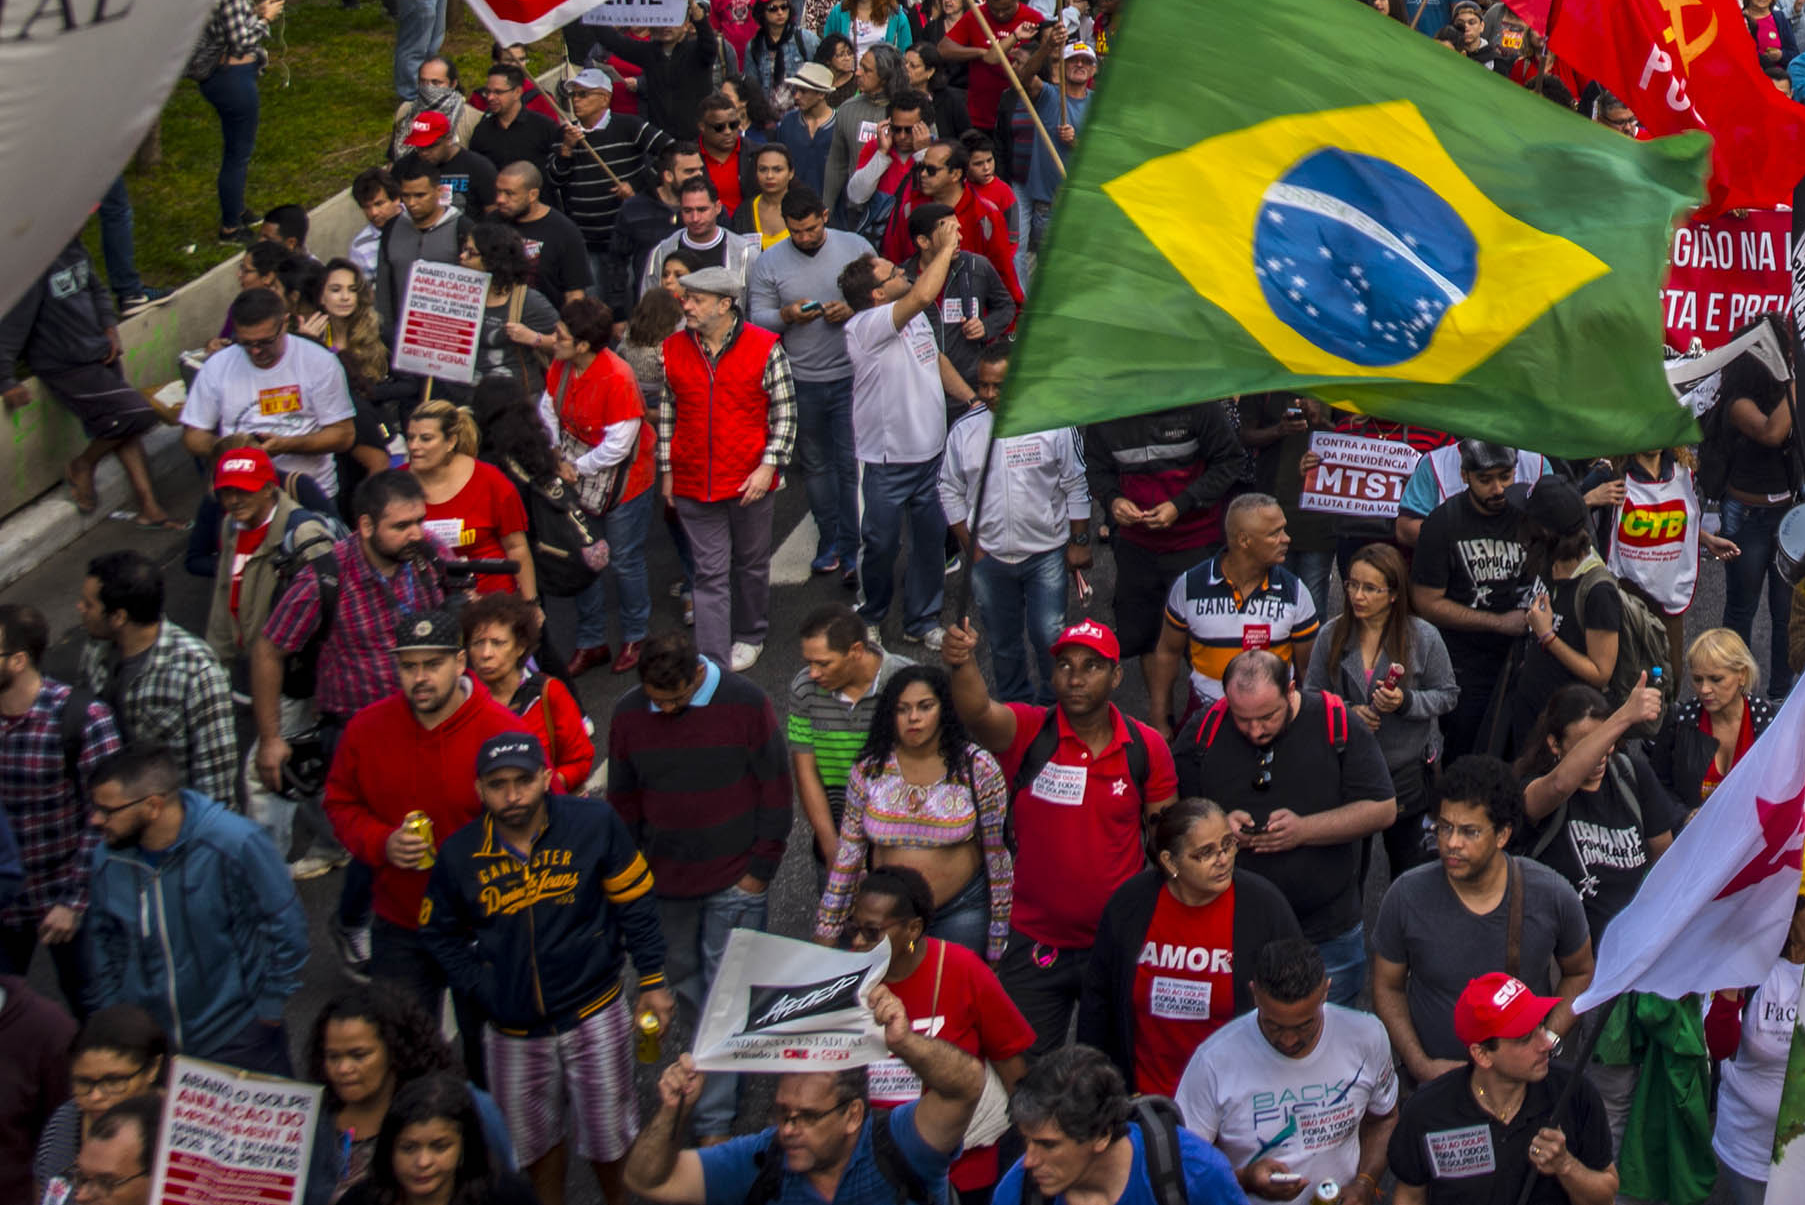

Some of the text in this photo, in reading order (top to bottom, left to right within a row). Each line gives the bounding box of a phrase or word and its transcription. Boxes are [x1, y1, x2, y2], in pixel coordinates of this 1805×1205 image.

[1740, 231, 1776, 272] NA
[1704, 292, 1724, 332] E
[1316, 436, 1422, 459] CONTRA A REFORMA
[1323, 450, 1409, 471] DA PREVIDÊNCIA
[1315, 464, 1405, 501] MTST
[1308, 496, 1315, 506] A
[1318, 498, 1344, 509] LUTA
[1354, 500, 1376, 512] PRA
[1623, 509, 1687, 539] CTB
[1136, 940, 1233, 974] AMOR
[1493, 977, 1523, 1006] CUT
[1253, 1078, 1345, 1109] BACK
